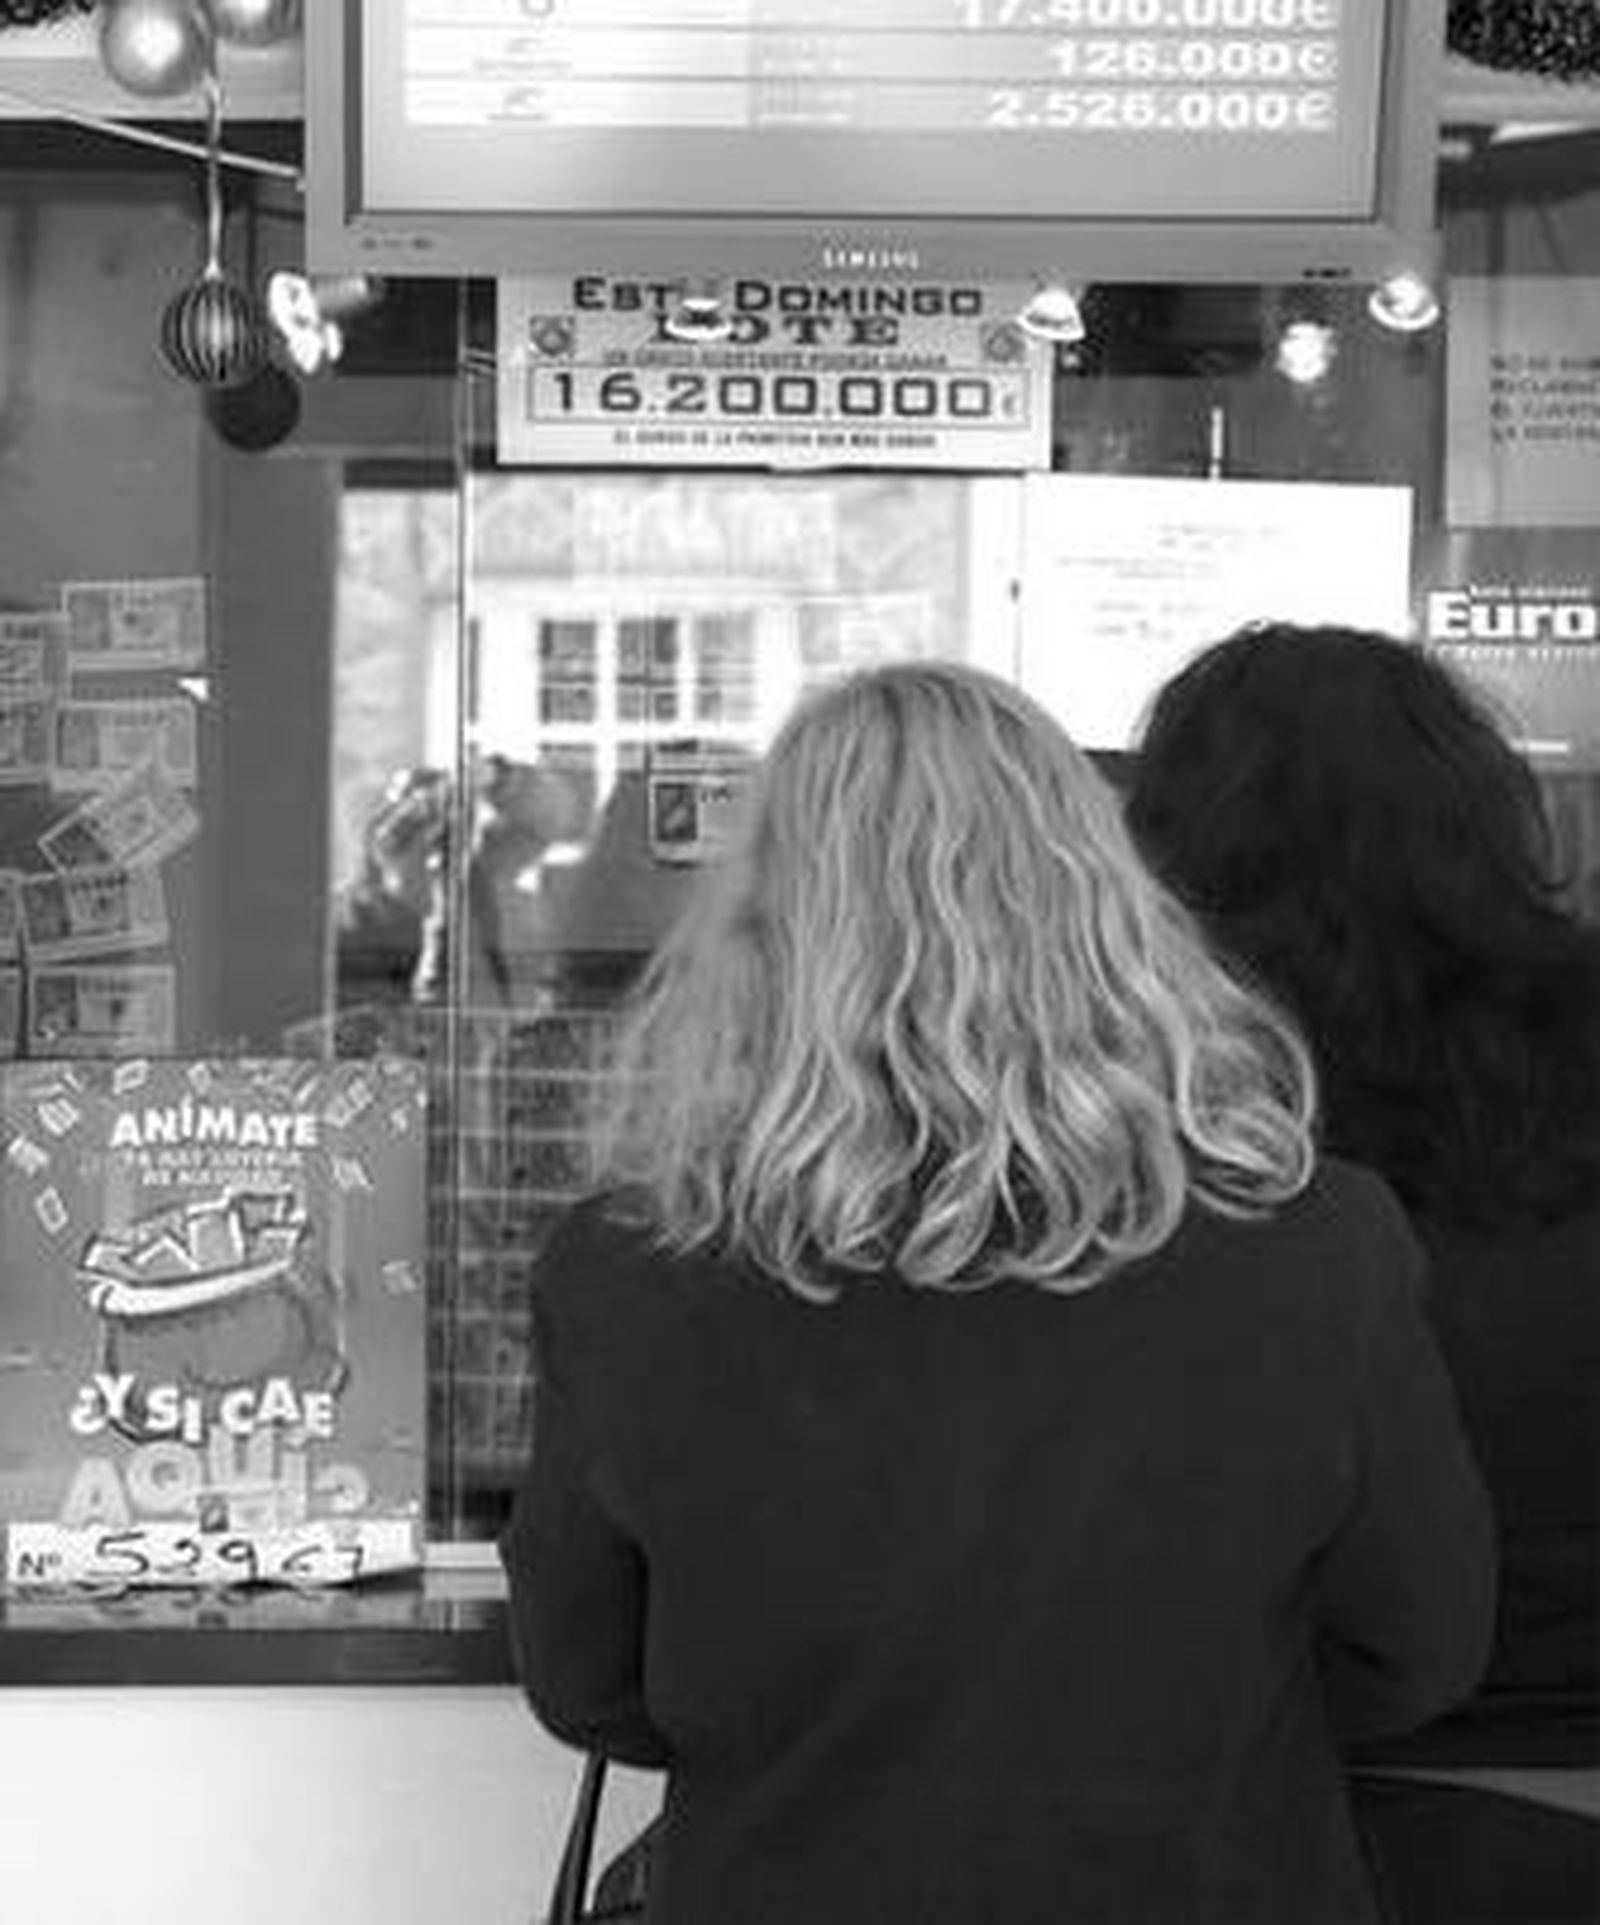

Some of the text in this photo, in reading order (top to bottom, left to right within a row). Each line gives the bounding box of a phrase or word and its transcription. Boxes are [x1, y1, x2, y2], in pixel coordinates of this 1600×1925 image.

[1052, 41, 1337, 77] 126.000€
[989, 91, 1335, 128] 2.526.000€
[575, 276, 981, 316] EST DOMINGO
[1429, 591, 1596, 638] Euro
[144, 1387, 202, 1443] SI
[219, 1377, 333, 1438] CAE
